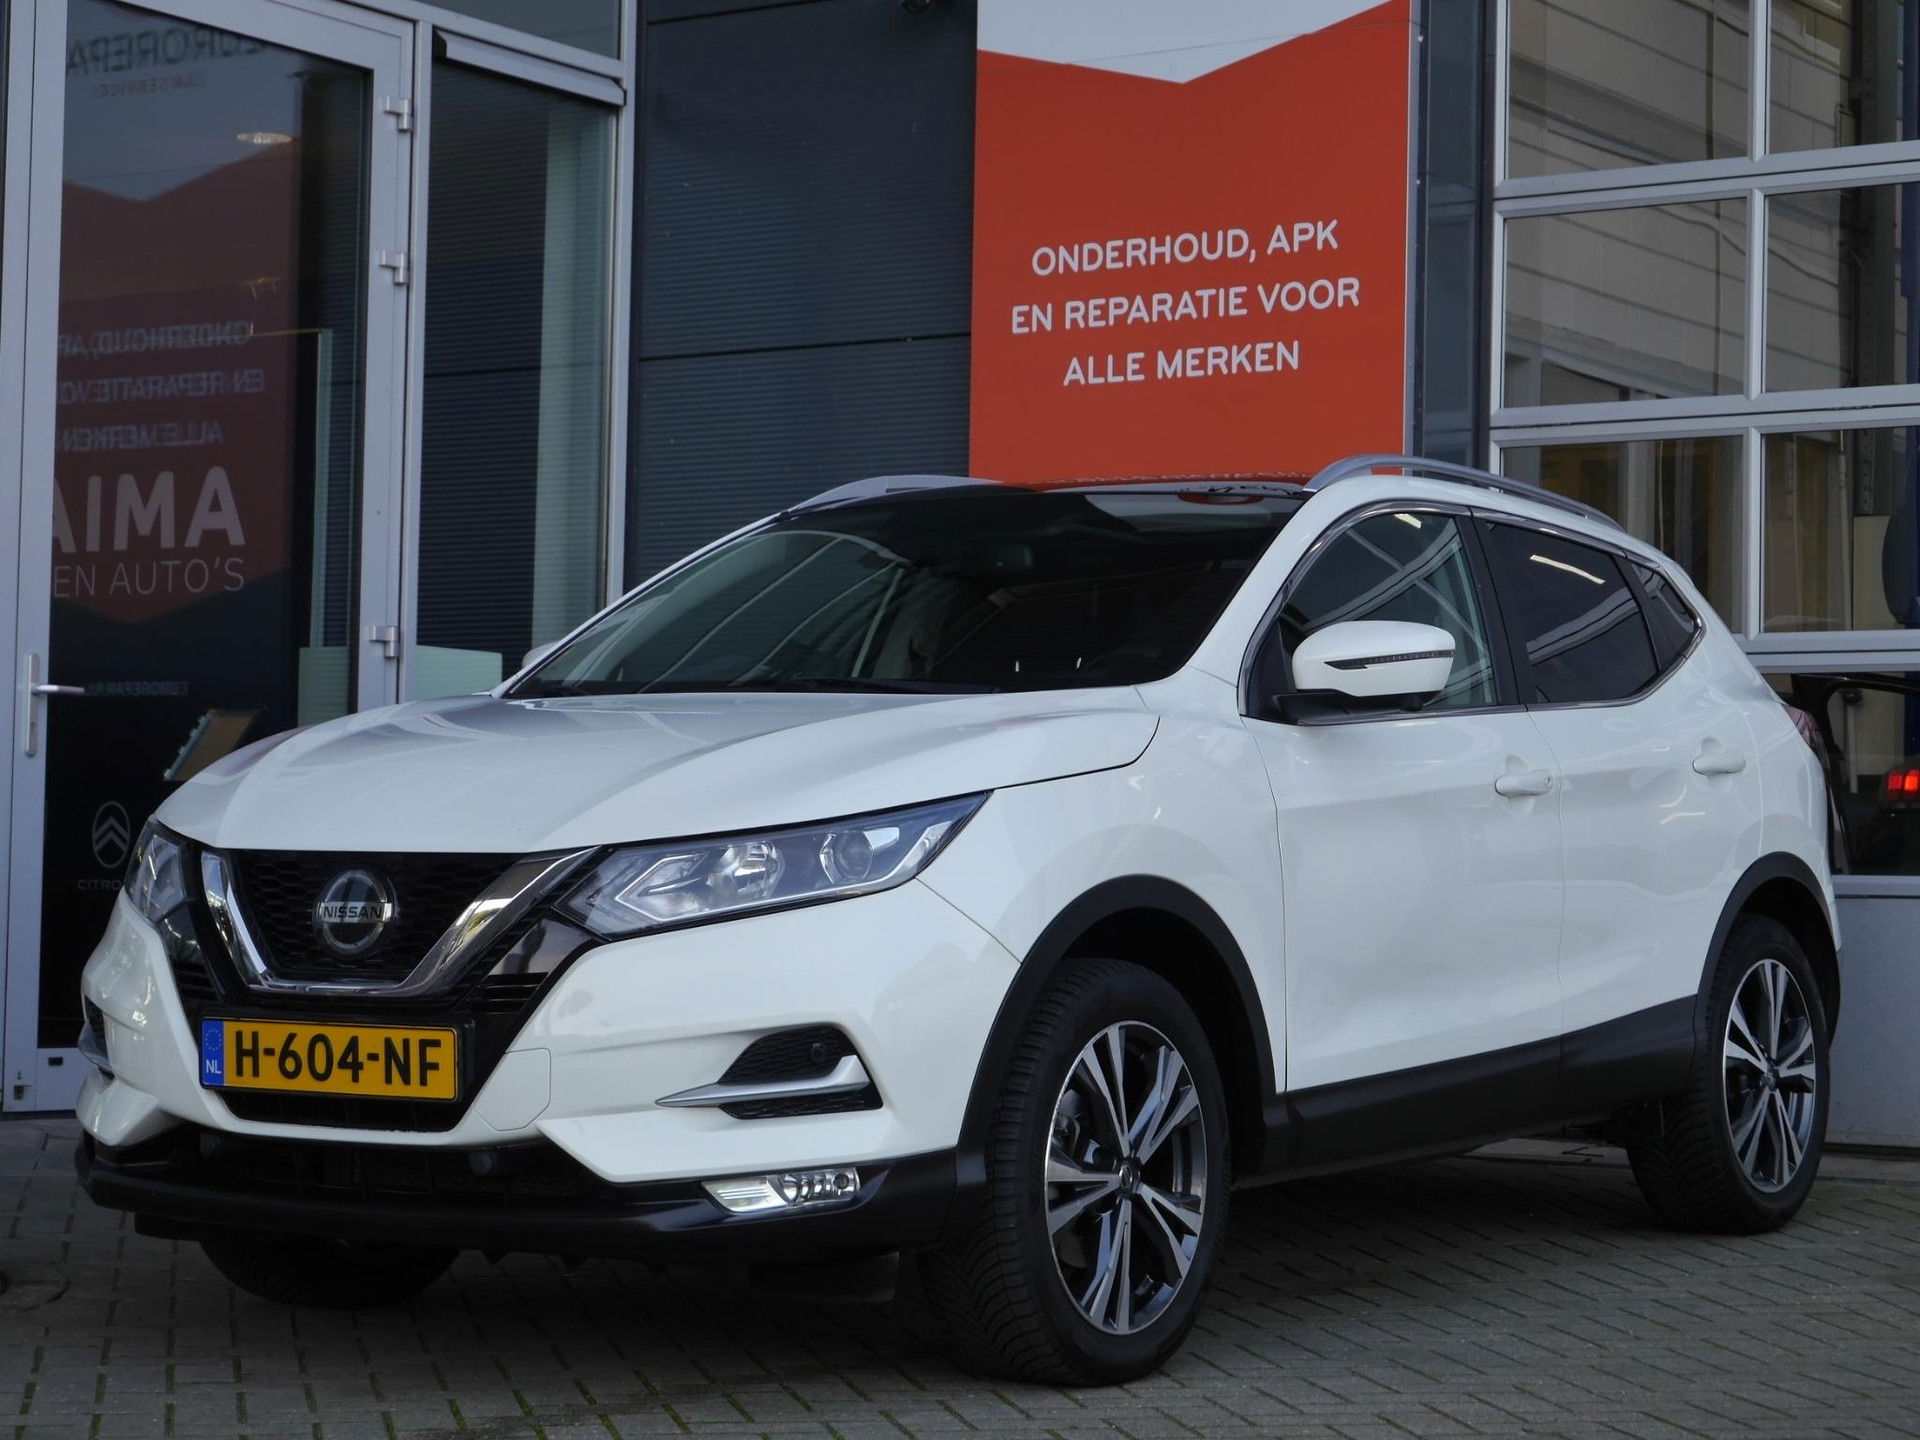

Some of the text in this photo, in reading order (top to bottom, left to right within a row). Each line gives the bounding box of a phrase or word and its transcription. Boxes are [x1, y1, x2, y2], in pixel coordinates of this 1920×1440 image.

[1031, 219, 1339, 276] ONDERHOUD, APK
[1011, 277, 1360, 334] EN REPARATIE VOOR
[1063, 340, 1299, 387] ALLE MERKEN
[109, 557, 244, 595] AUTO'S
[323, 905, 384, 920] NISSAN
[206, 1060, 222, 1075] NL
[235, 1030, 441, 1087] H-604-NF
